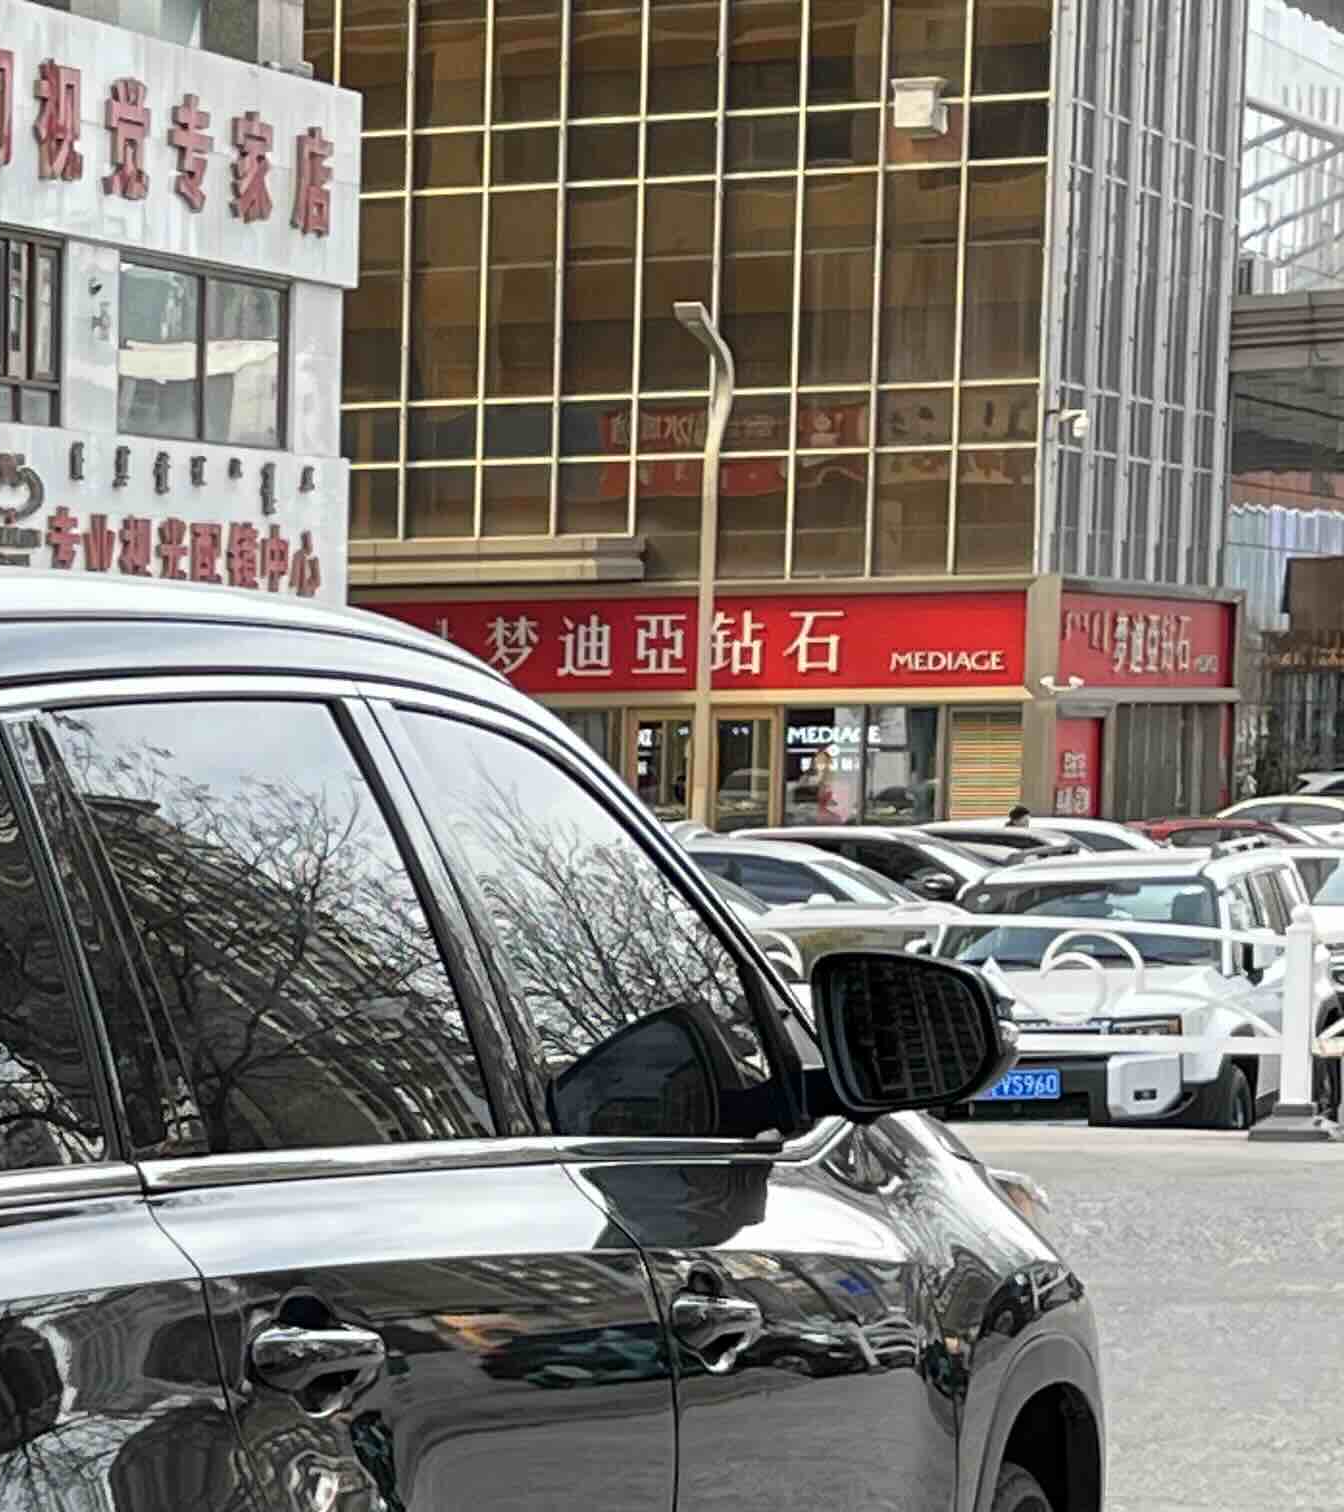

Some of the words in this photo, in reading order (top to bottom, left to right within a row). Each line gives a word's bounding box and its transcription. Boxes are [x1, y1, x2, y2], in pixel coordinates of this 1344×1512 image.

[45, 505, 322, 599] 专业视光配镜中心
[889, 650, 1005, 673] MEDIAGE
